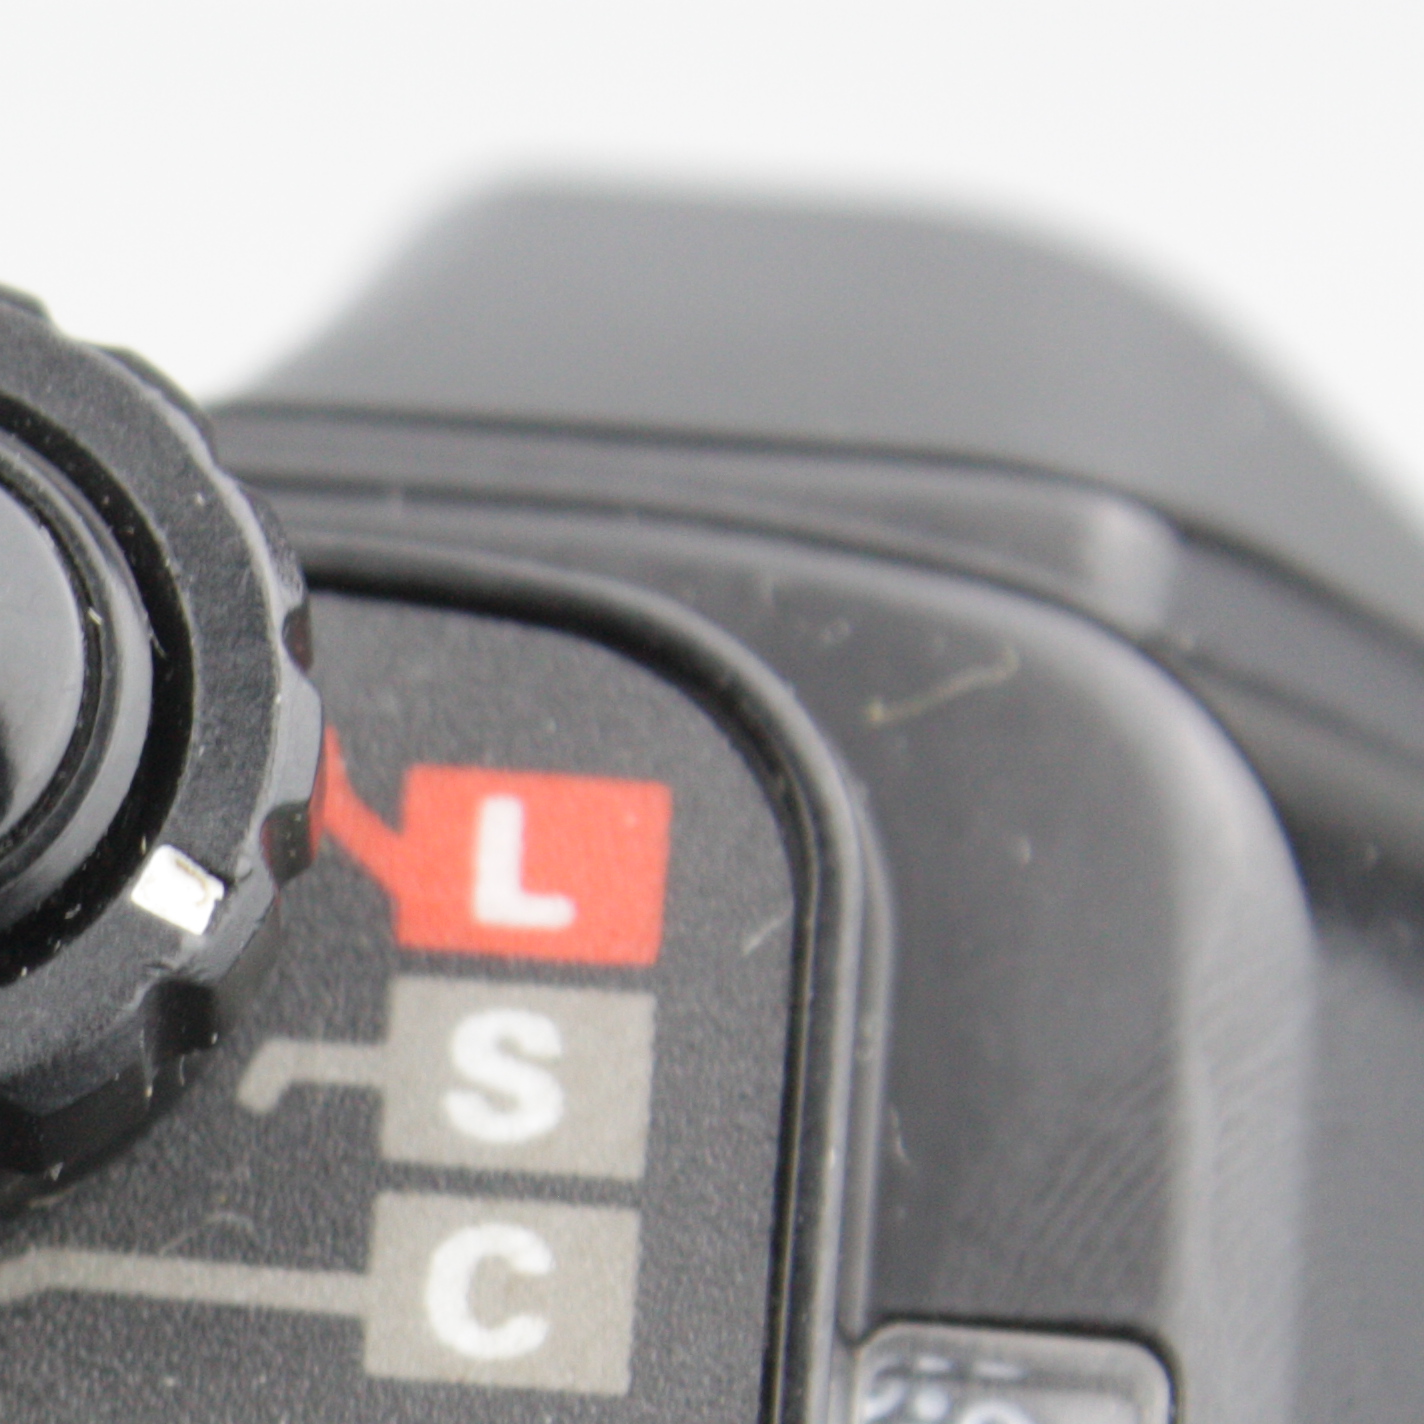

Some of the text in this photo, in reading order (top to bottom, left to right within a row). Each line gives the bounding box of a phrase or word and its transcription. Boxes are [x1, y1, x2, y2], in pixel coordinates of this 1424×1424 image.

[472, 795, 576, 930] L
[445, 1008, 564, 1143] S
[424, 1223, 556, 1361] C
